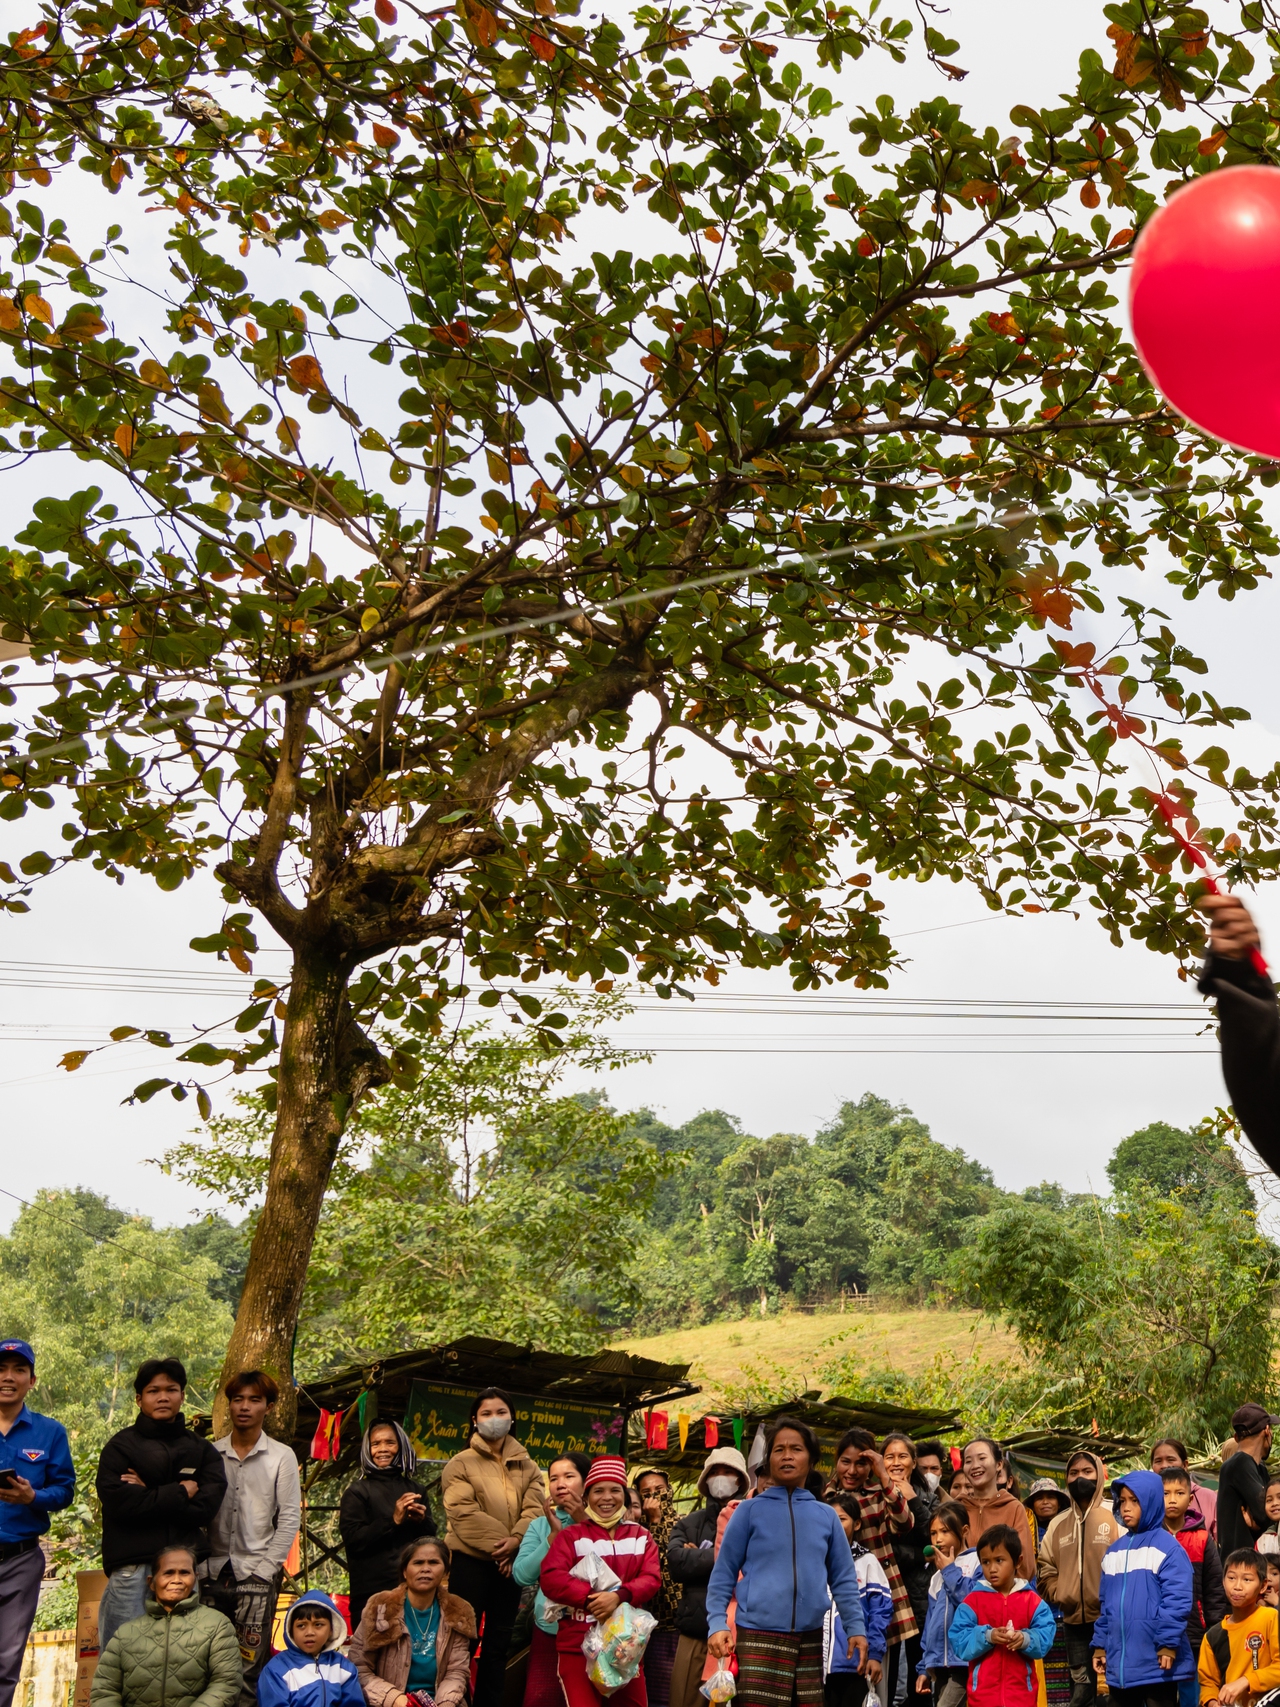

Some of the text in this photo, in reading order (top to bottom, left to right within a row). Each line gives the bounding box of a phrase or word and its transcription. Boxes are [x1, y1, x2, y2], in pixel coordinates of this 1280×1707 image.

[424, 1415, 458, 1440] Xuân
[531, 1411, 565, 1426] TRÌNH
[524, 1423, 541, 1447] Ấm
[542, 1432, 565, 1455] Lòng
[567, 1435, 586, 1452] Dân
